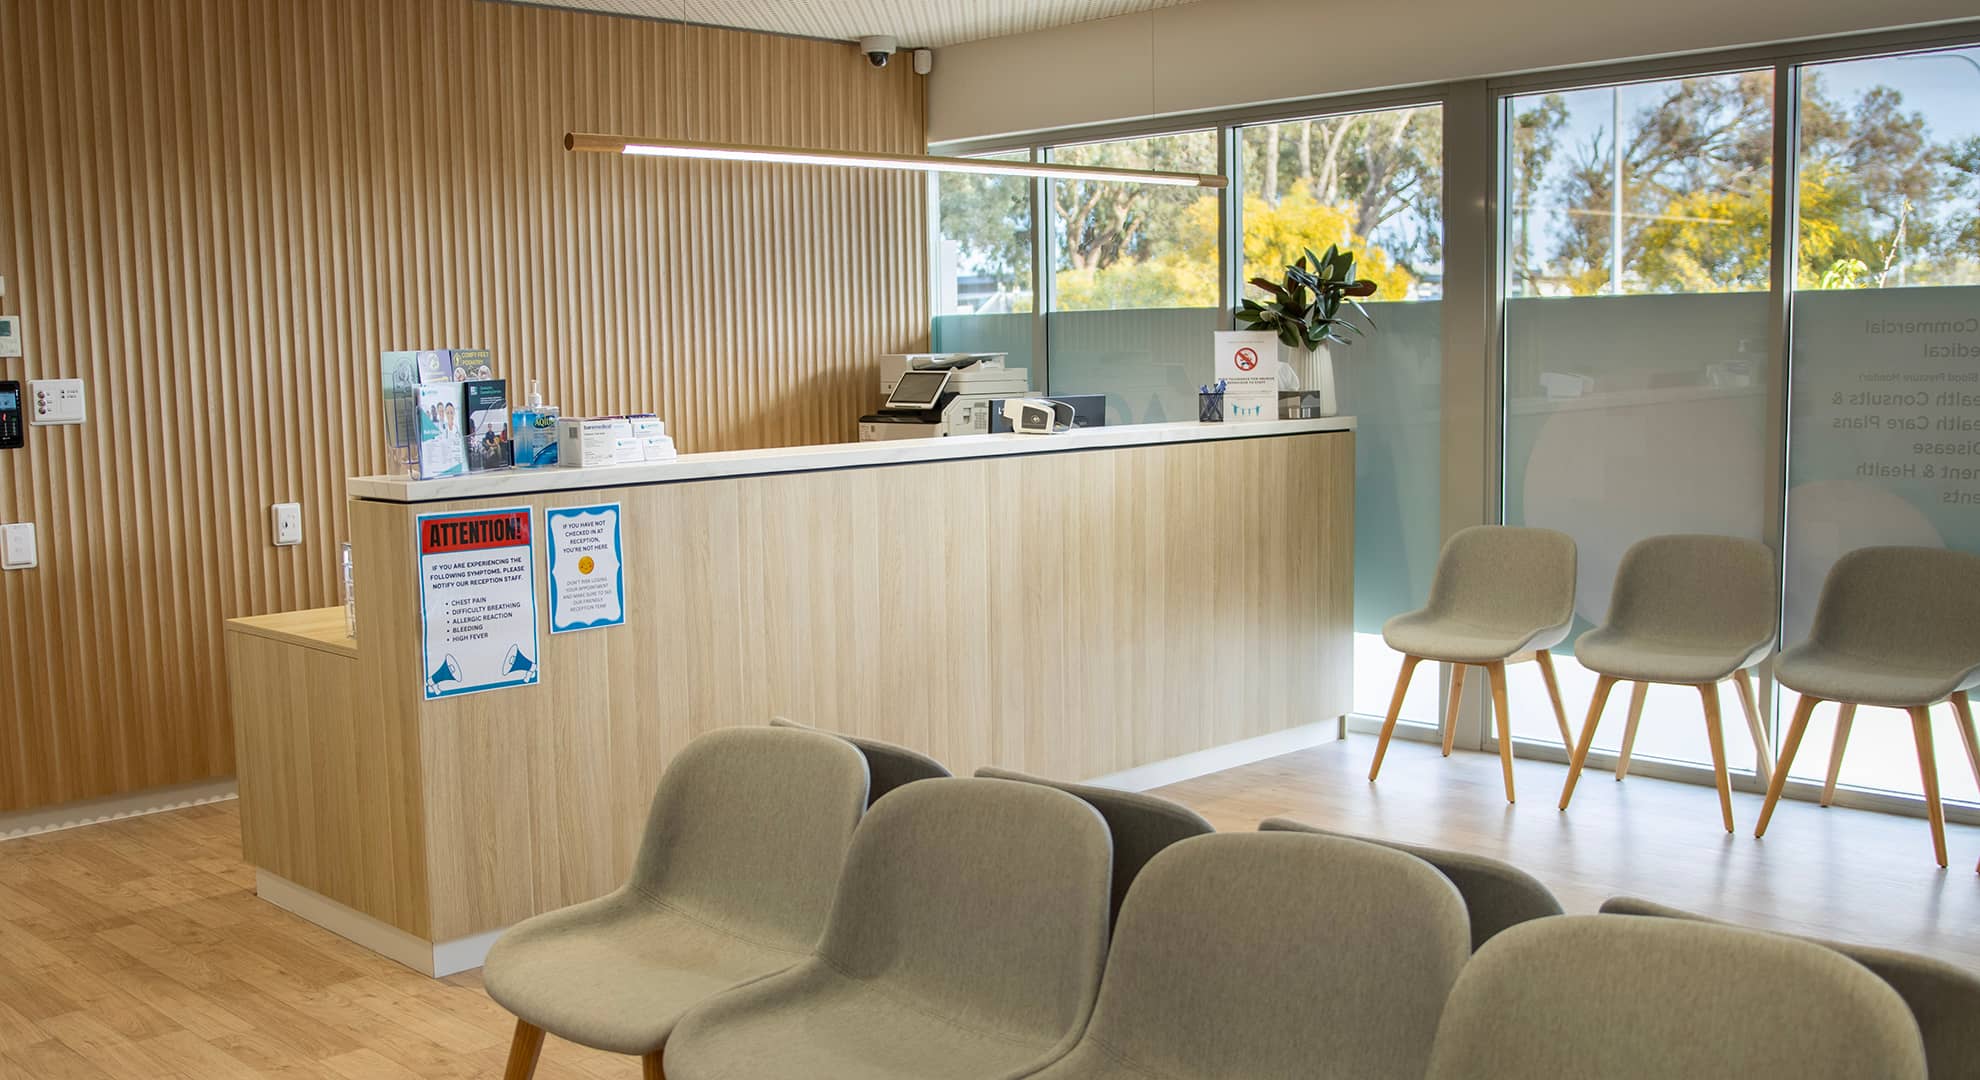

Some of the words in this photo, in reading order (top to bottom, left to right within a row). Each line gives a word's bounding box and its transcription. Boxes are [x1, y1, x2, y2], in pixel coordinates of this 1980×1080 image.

[430, 517, 522, 548] ATTENTION!
[467, 558, 509, 568] EXPERIENCING
[430, 572, 466, 580] FOLLOWING
[432, 581, 455, 590] NOTIFY
[470, 576, 503, 586] RECEPTION
[452, 607, 486, 615] DIFFICULTY
[487, 602, 520, 611] BREATHING
[452, 616, 482, 624] ALLERGIC
[483, 612, 512, 621] REACTION
[452, 624, 483, 633] BLEEDING
